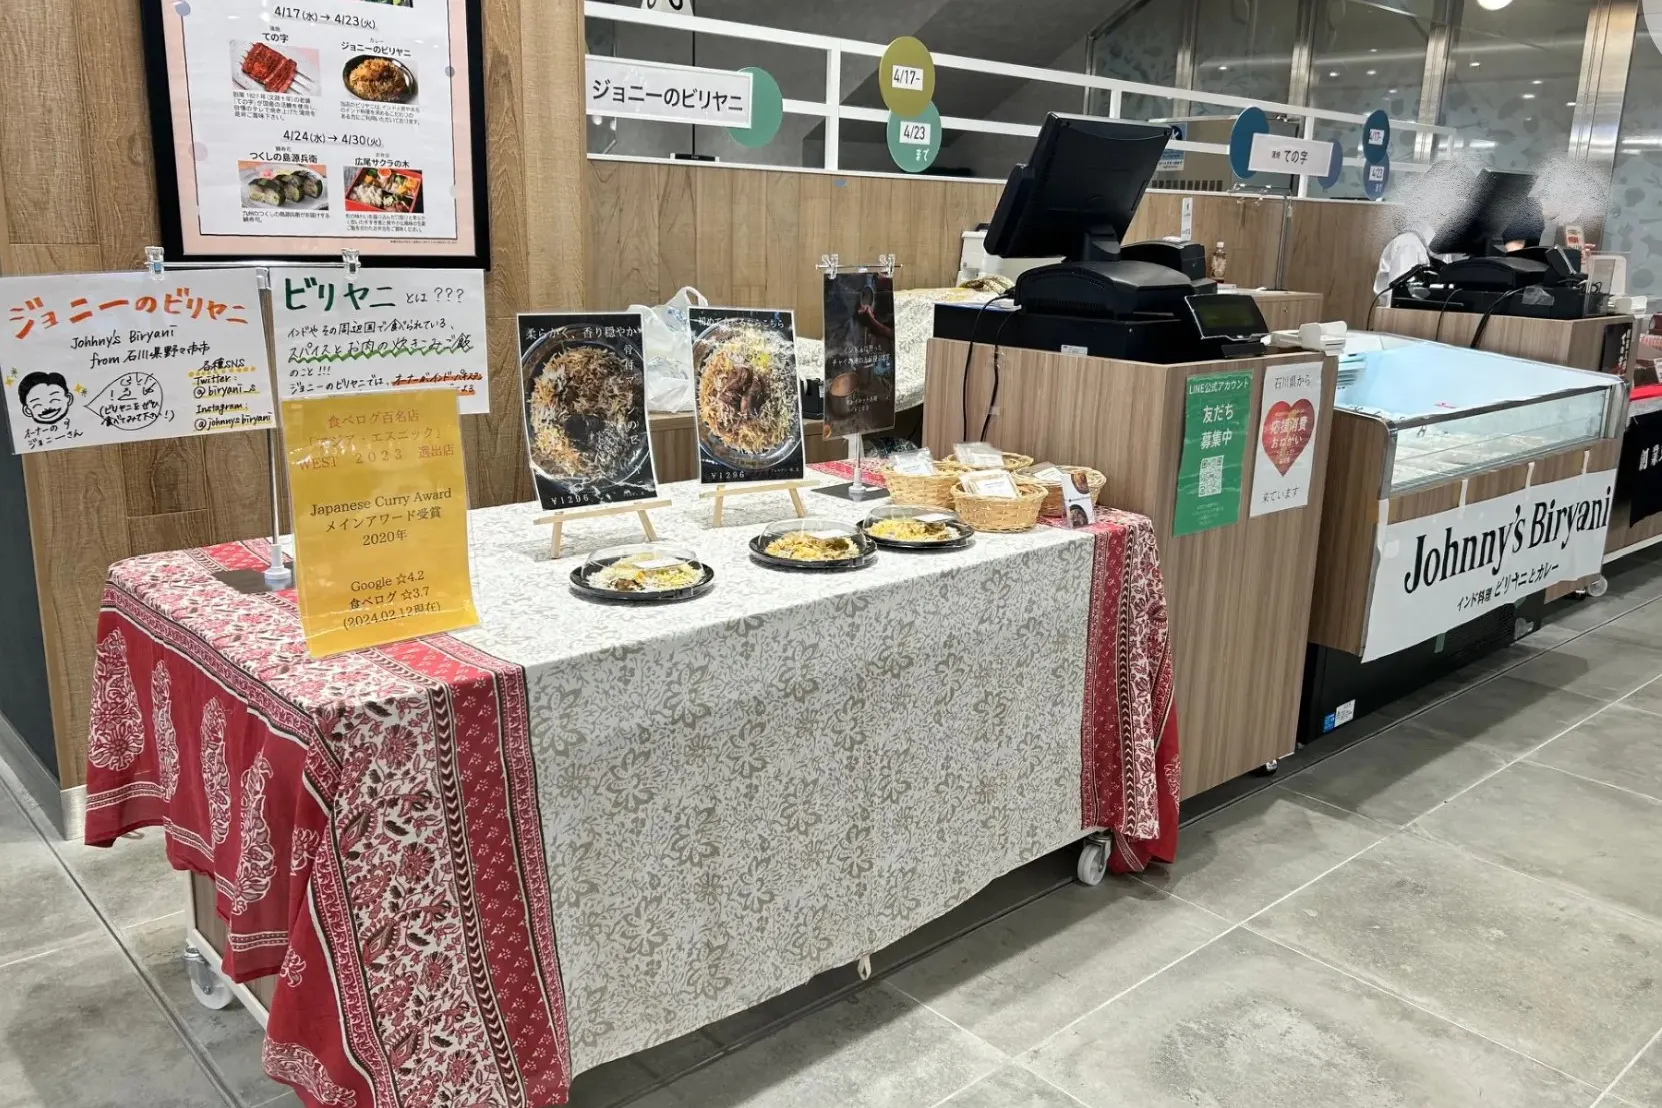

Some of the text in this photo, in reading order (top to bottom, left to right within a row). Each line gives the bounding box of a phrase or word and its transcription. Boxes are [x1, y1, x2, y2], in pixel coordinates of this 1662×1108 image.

[274, 6, 376, 29] 4/17(水) 4/23(火)
[261, 32, 289, 43] ての字
[341, 41, 412, 57] ジョニーのビリヤニ
[593, 79, 743, 111] ジョニーのビリヤニ
[283, 130, 382, 148] 4/24(水) 4/30(火)
[903, 124, 925, 140] 4/23
[250, 152, 318, 163] つくしの島源兵衛
[354, 157, 410, 168] 広尾サクラの木
[1284, 149, 1308, 165] ての字
[285, 276, 465, 312] ビリヤニ とは ???
[9, 287, 249, 340] ジョニーのビリヤニ
[129, 324, 178, 344] Biryani
[287, 332, 474, 363] スパイスとお肉の炊きこみご飯
[90, 352, 121, 370] from
[200, 358, 245, 372] 各種SNS
[1189, 378, 1249, 395] LINE公式アカウント
[1274, 374, 1311, 390] 石川県から
[328, 408, 421, 429] 食べログ百名店
[1202, 403, 1235, 424] 友だち
[27, 429, 84, 450] ジョニーさん
[1200, 428, 1233, 450] 募集中
[418, 444, 454, 459] 選出店
[310, 488, 452, 517] Japanese Curry Award
[1261, 487, 1300, 503] 来ています
[325, 505, 443, 533] メインアワード受賞
[362, 529, 408, 546] 2020年
[1403, 486, 1612, 594] Johnny's Biryani
[351, 576, 393, 593] Google
[1457, 562, 1560, 612] インド料理 ビリヤニとカレー
[349, 590, 397, 609] 食べログ
